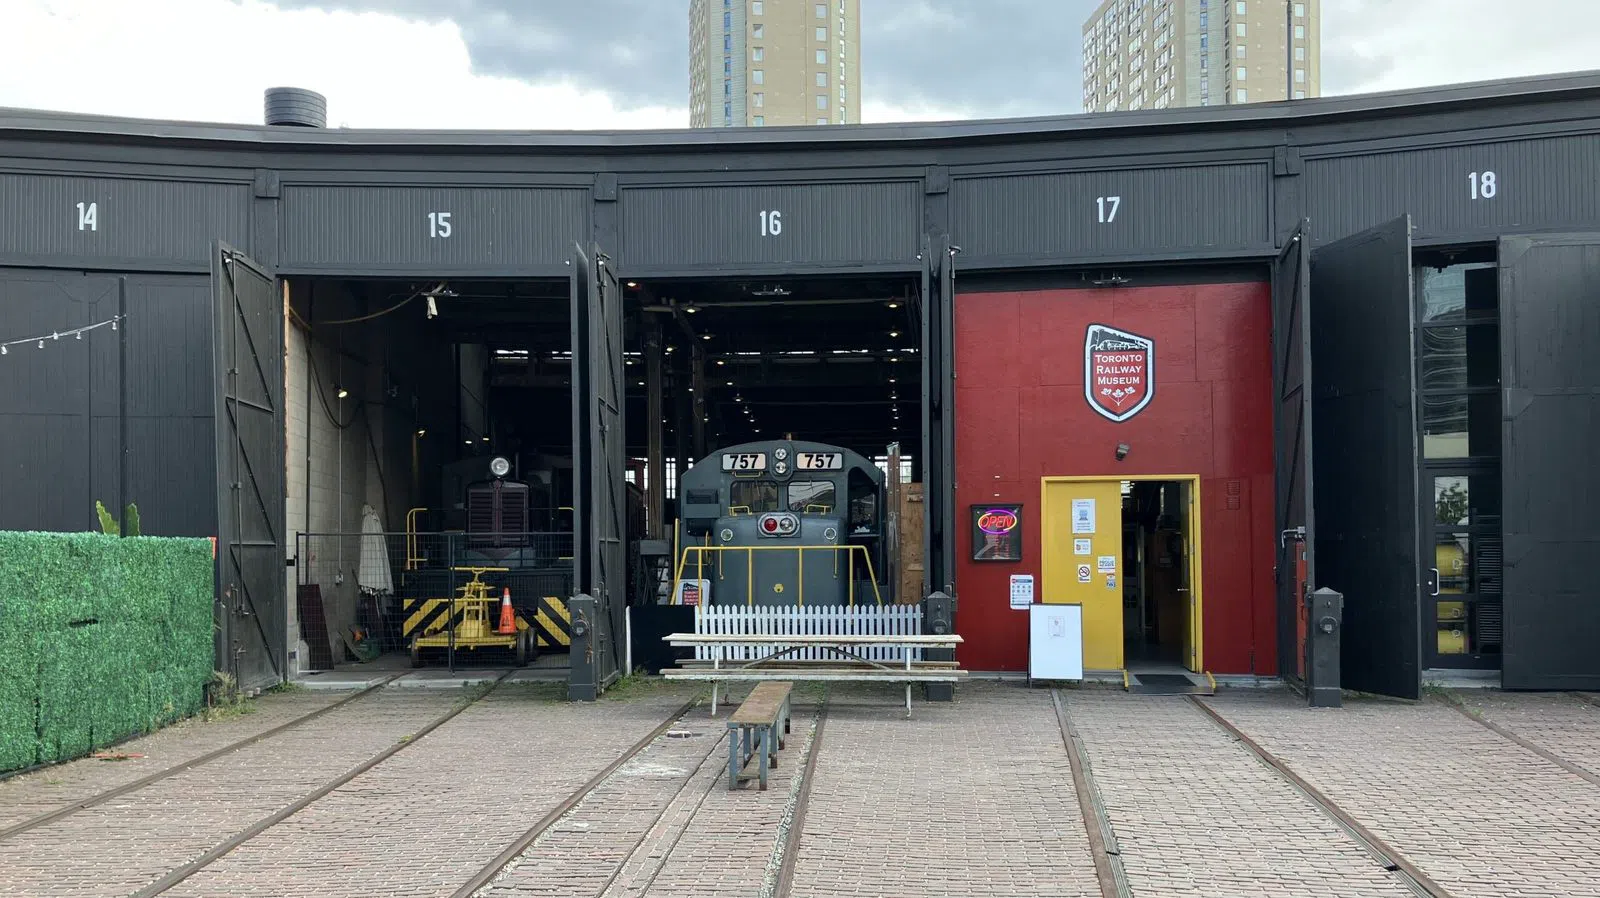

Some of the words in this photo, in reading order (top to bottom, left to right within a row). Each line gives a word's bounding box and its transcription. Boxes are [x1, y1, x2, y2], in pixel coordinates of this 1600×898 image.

[1468, 171, 1496, 199] 18
[76, 202, 98, 231] 14
[1096, 196, 1120, 223] 17
[428, 212, 452, 238] 15
[759, 210, 782, 236] 16
[1095, 354, 1142, 363] TORONTO
[1096, 366, 1142, 374] RAILWAY
[1097, 377, 1140, 385] MUSEUM
[729, 455, 759, 469] 757
[804, 454, 835, 468] 757
[980, 515, 1013, 529] OPEN
